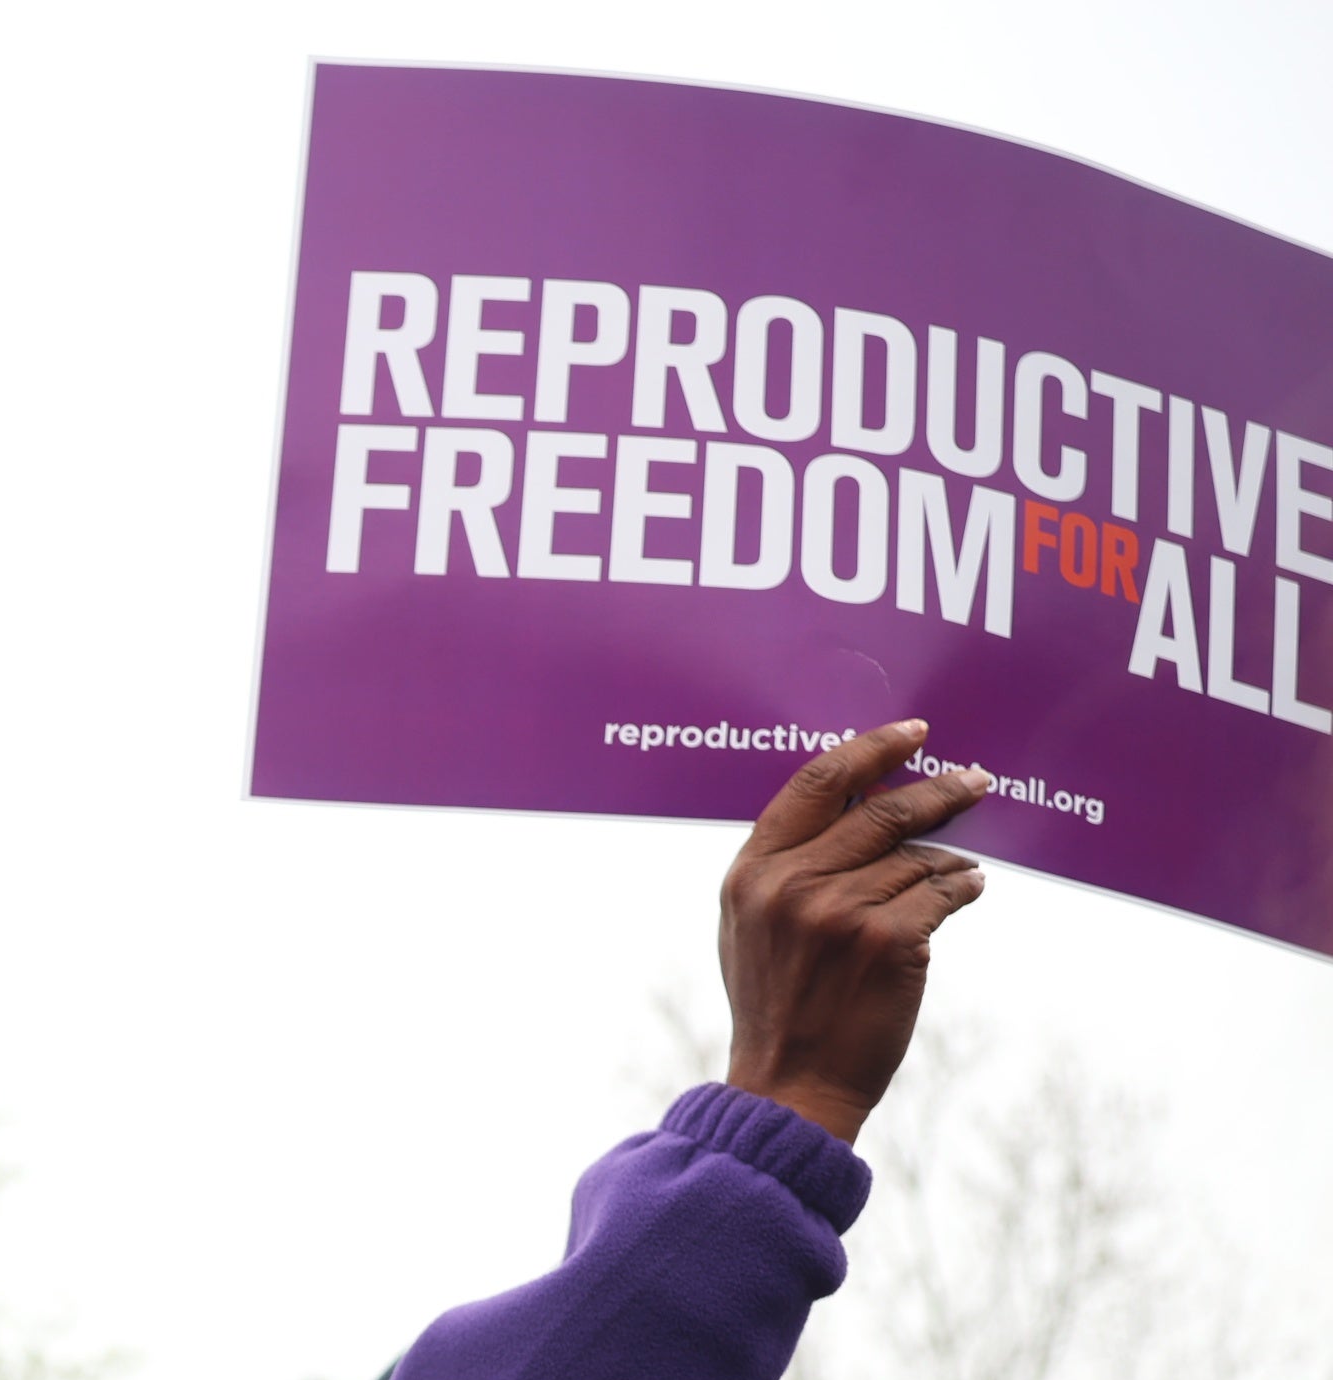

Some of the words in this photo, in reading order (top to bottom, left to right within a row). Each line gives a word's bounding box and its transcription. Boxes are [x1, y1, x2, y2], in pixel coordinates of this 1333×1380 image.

[339, 268, 1333, 579] REPRODUCTIVE
[325, 424, 1017, 639] FREEDOM
[1022, 500, 1141, 603] FOR
[1126, 541, 1333, 735] ALL
